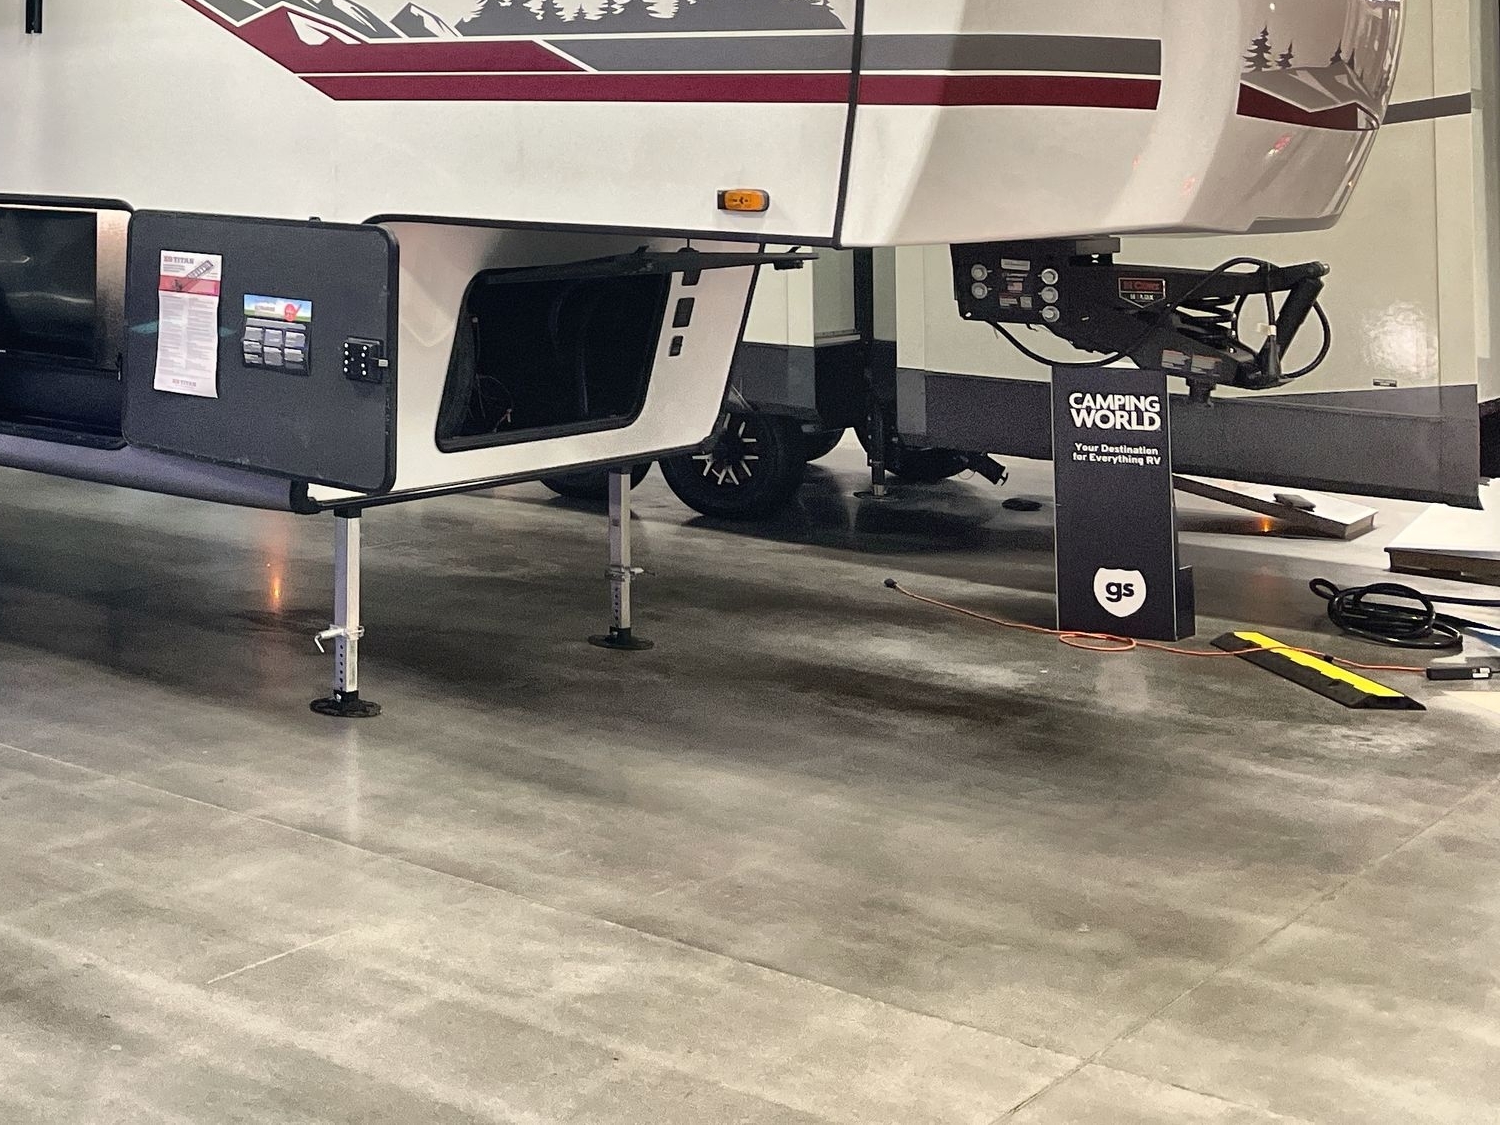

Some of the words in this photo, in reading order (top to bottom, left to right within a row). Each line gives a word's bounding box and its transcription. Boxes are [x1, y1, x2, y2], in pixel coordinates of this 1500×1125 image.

[1069, 392, 1161, 413] CAMPING
[1070, 408, 1162, 431] WORLD
[1072, 452, 1087, 461] for
[1089, 453, 1144, 466] Everything
[1146, 456, 1161, 465] RV
[1074, 442, 1099, 452] Your
[1100, 443, 1159, 455] Destination
[1105, 581, 1135, 603] gs
